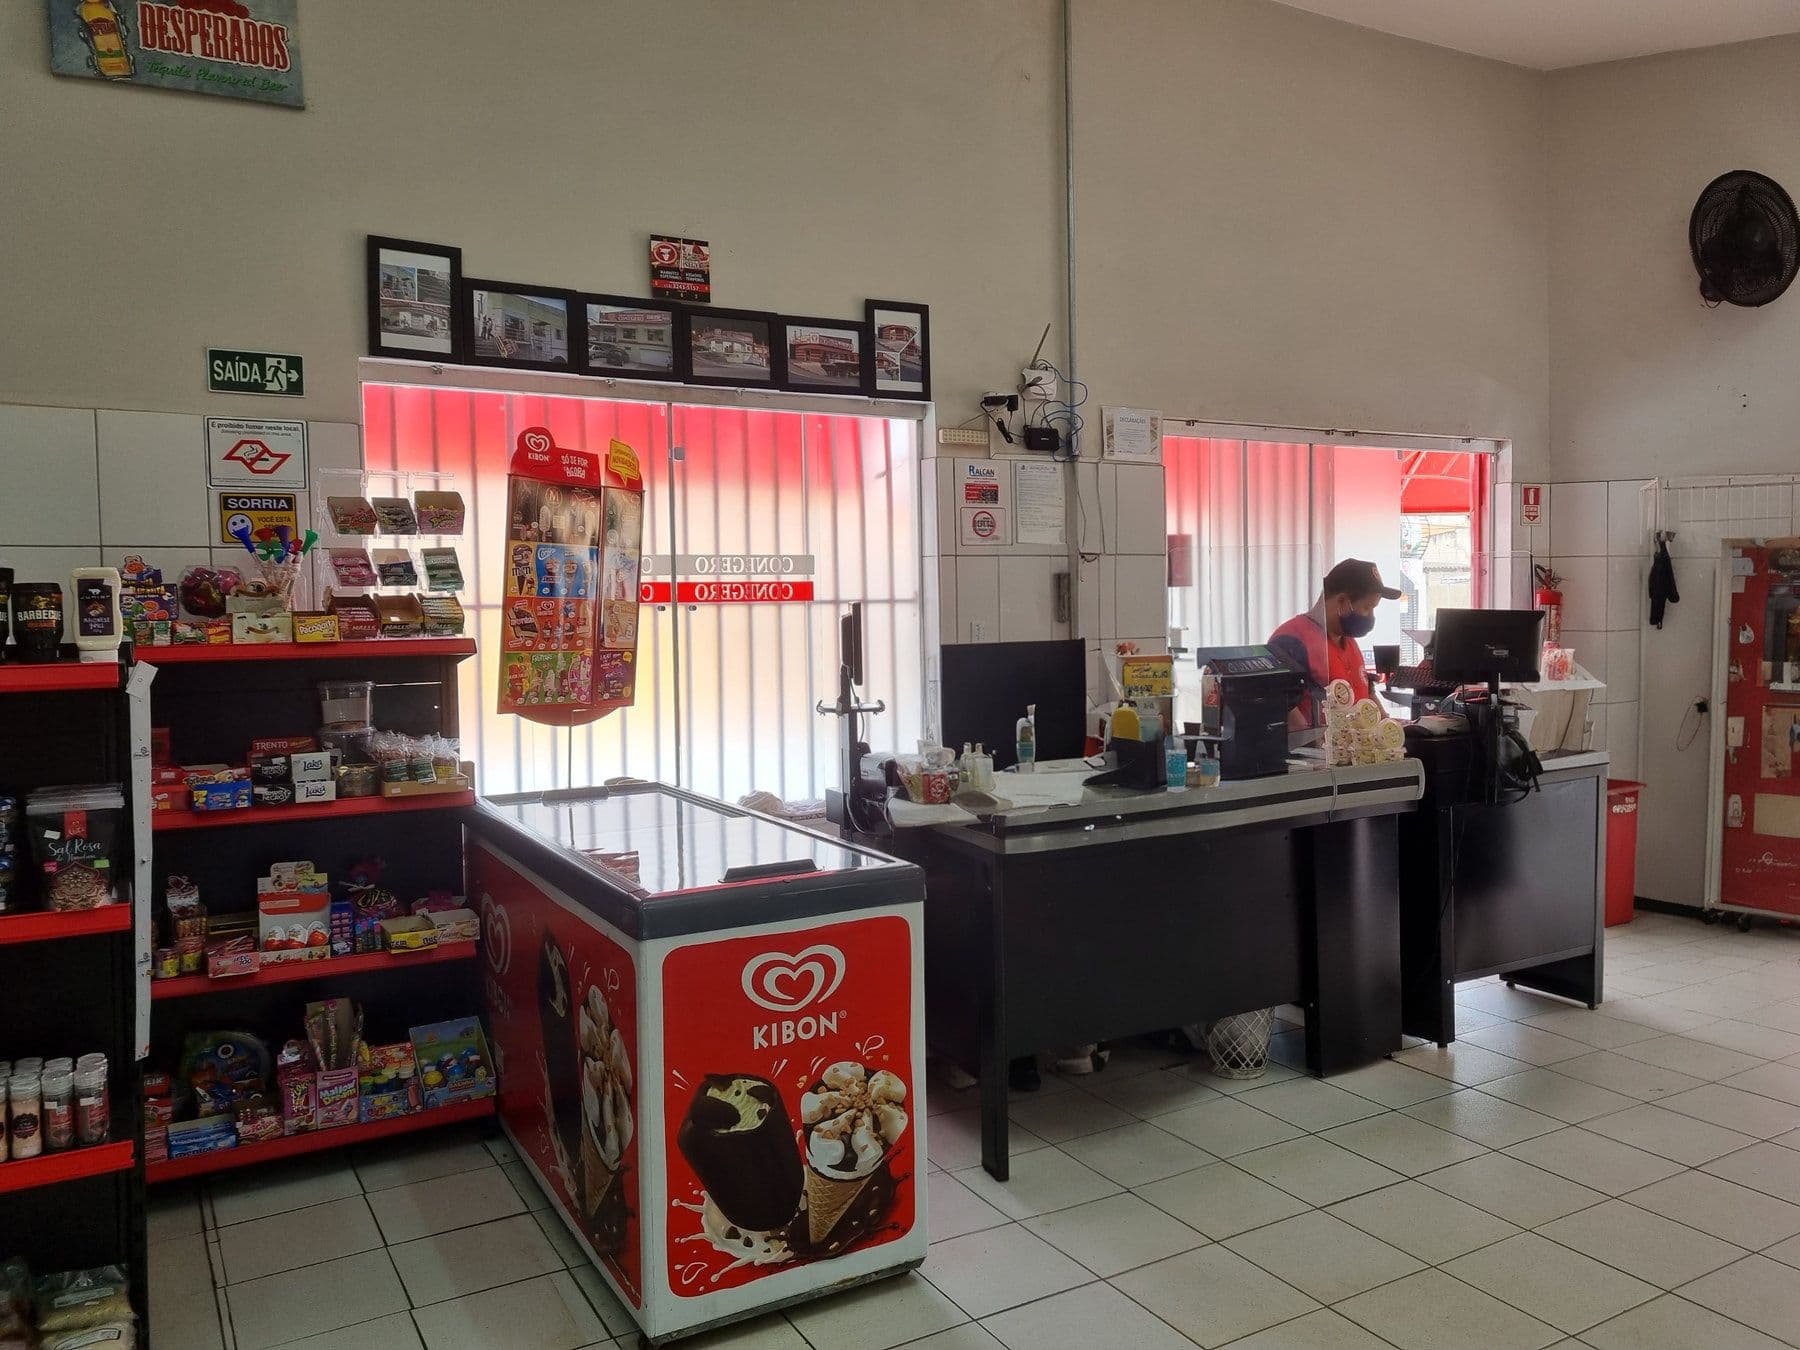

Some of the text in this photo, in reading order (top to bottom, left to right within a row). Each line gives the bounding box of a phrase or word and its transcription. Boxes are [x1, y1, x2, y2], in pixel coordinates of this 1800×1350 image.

[140, 4, 290, 70] DESPERADOS
[213, 356, 262, 384] SAÍDA
[528, 452, 549, 462] KIBON
[968, 464, 995, 477] RALCAN
[228, 497, 289, 509] SORRIA
[17, 609, 62, 622] BARBECUE
[255, 741, 288, 751] TRENTO
[48, 838, 102, 857] Sal Rosa
[752, 1011, 839, 1050] KIBON
